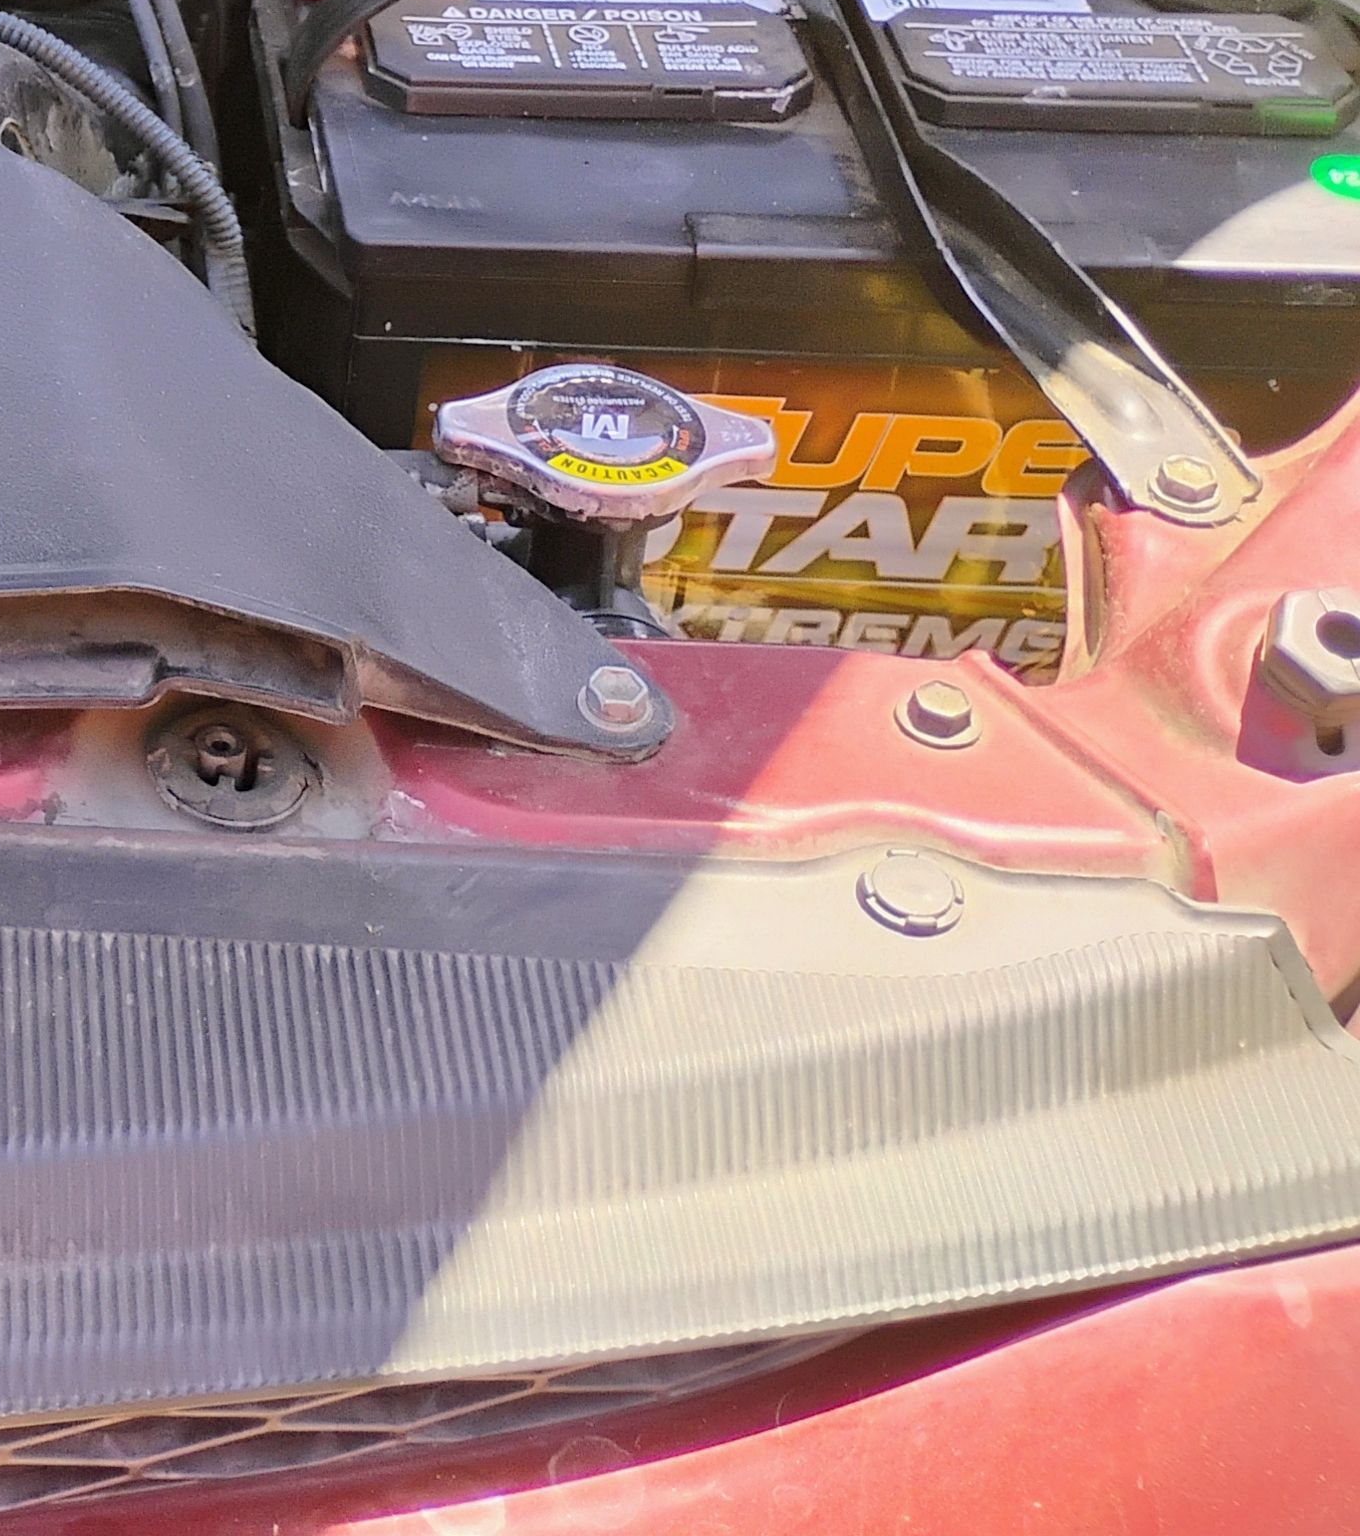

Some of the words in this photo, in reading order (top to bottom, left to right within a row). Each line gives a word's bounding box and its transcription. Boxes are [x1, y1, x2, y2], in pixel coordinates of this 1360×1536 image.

[468, 6, 577, 21] DANGER
[603, 8, 703, 22] POISON
[483, 26, 533, 35] SHIELD
[456, 40, 532, 50] EXPLOSIVE
[727, 44, 759, 54] ACID
[561, 458, 659, 480] CAUTION
[643, 490, 1064, 583] TAR
